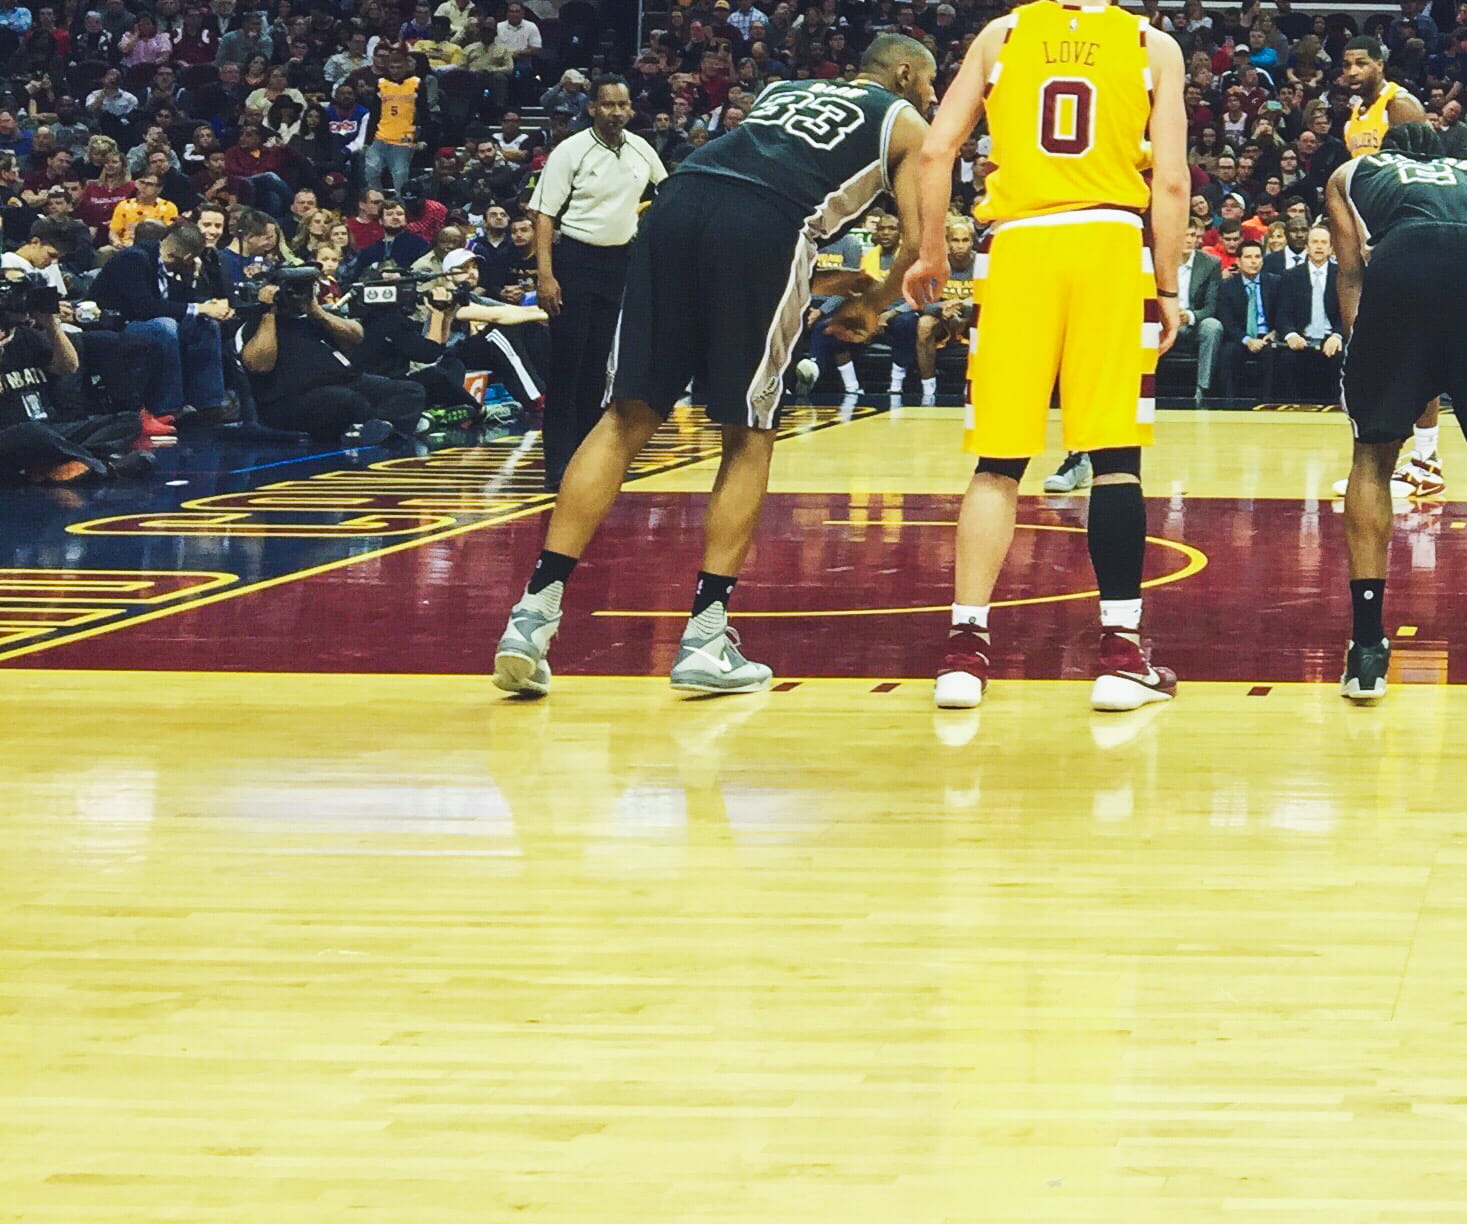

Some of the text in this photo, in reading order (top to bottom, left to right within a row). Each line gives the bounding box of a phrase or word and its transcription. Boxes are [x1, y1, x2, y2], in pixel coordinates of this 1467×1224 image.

[1041, 40, 1102, 67] LOVE
[390, 106, 399, 116] 5
[1038, 77, 1097, 156] 0
